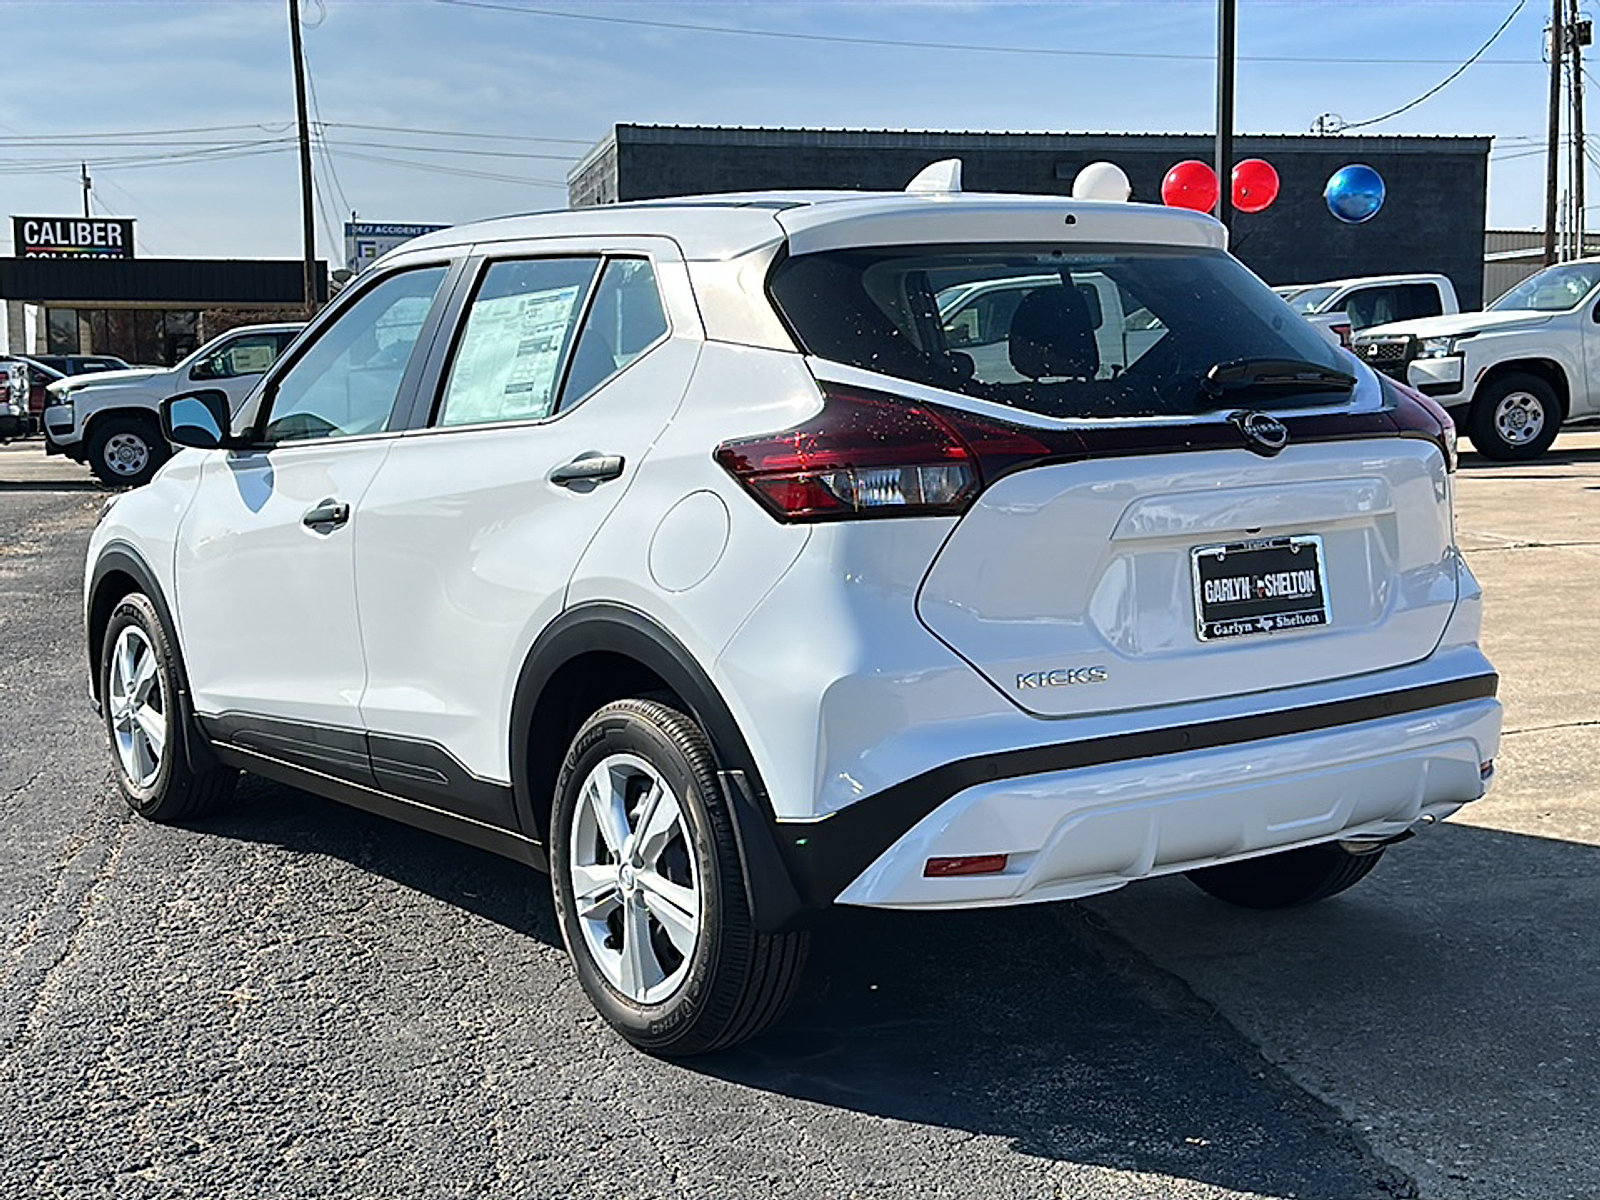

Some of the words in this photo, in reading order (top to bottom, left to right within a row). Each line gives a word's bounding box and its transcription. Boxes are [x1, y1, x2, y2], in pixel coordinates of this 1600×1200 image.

[23, 220, 123, 247] CALIBER
[1204, 576, 1250, 604] GARLYN
[1263, 569, 1317, 598] SHELTON
[1212, 622, 1253, 636] Garlyn
[1276, 613, 1320, 628] Shelton
[1016, 664, 1108, 690] KICKS
